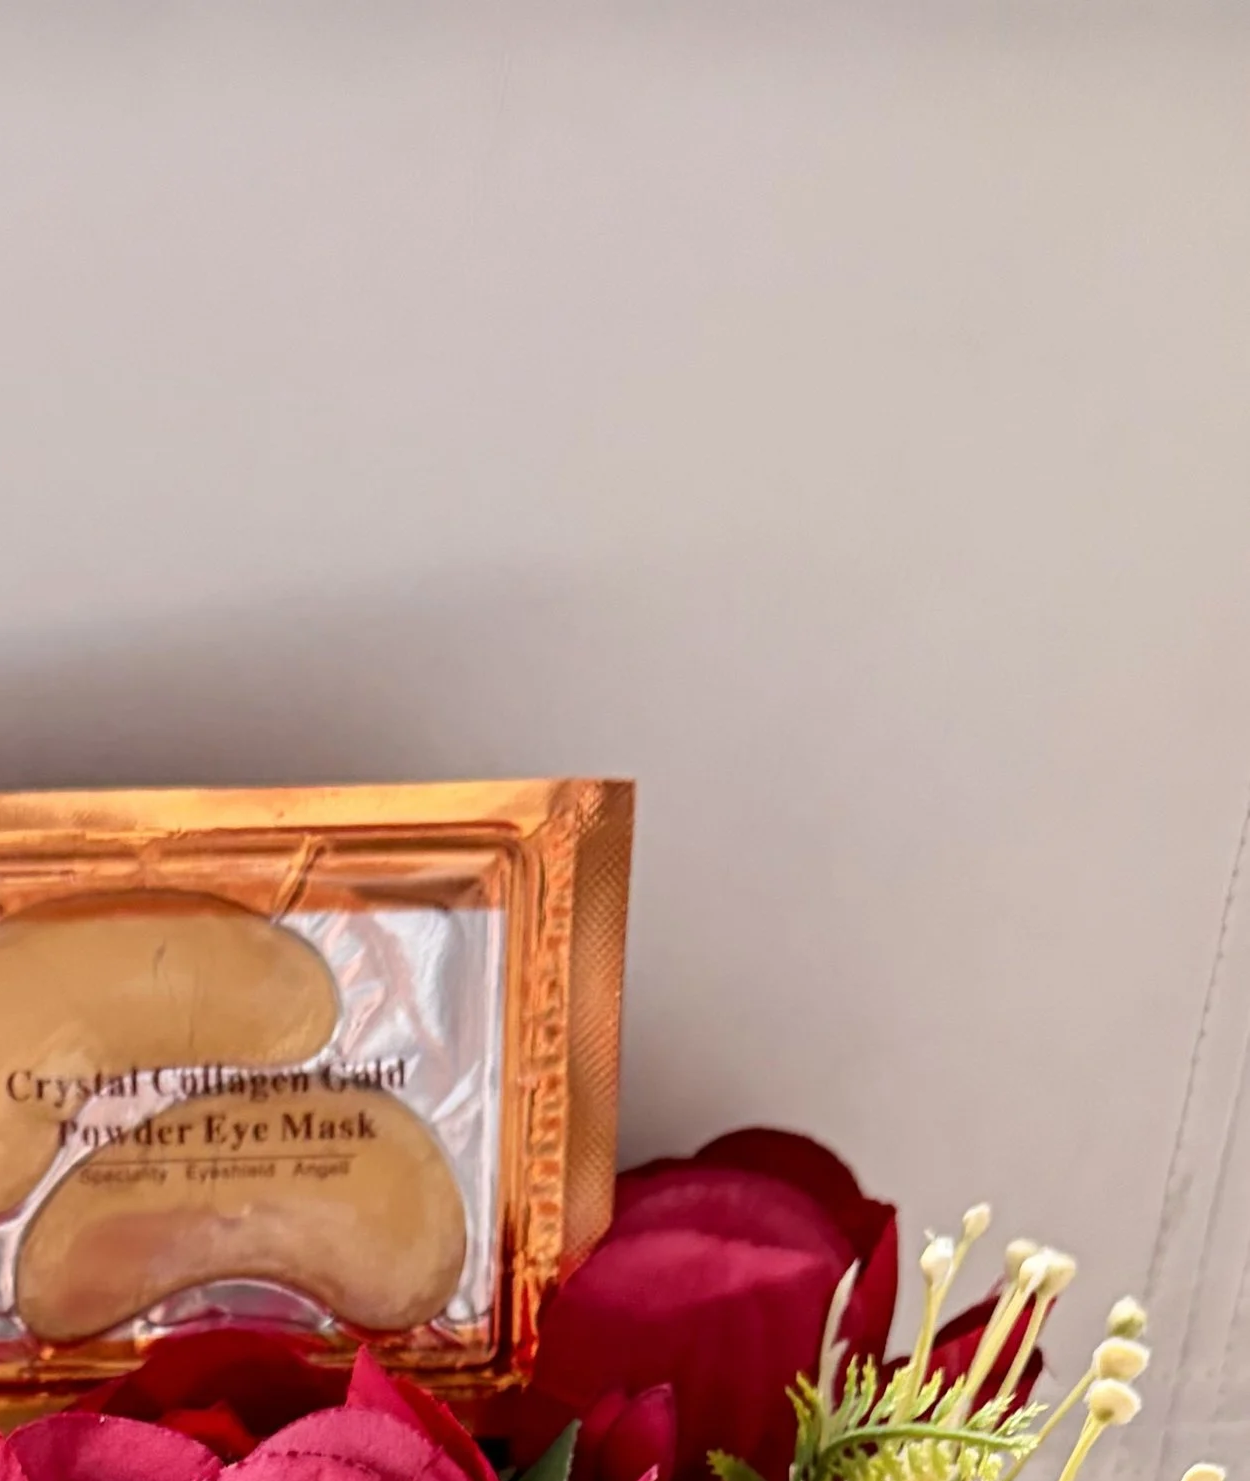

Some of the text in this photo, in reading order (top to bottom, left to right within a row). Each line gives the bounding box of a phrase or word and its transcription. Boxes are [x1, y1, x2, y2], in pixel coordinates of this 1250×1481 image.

[6, 1058, 405, 1108] Crystal Collagen Gold
[59, 1109, 377, 1151] Powder Eye Mask
